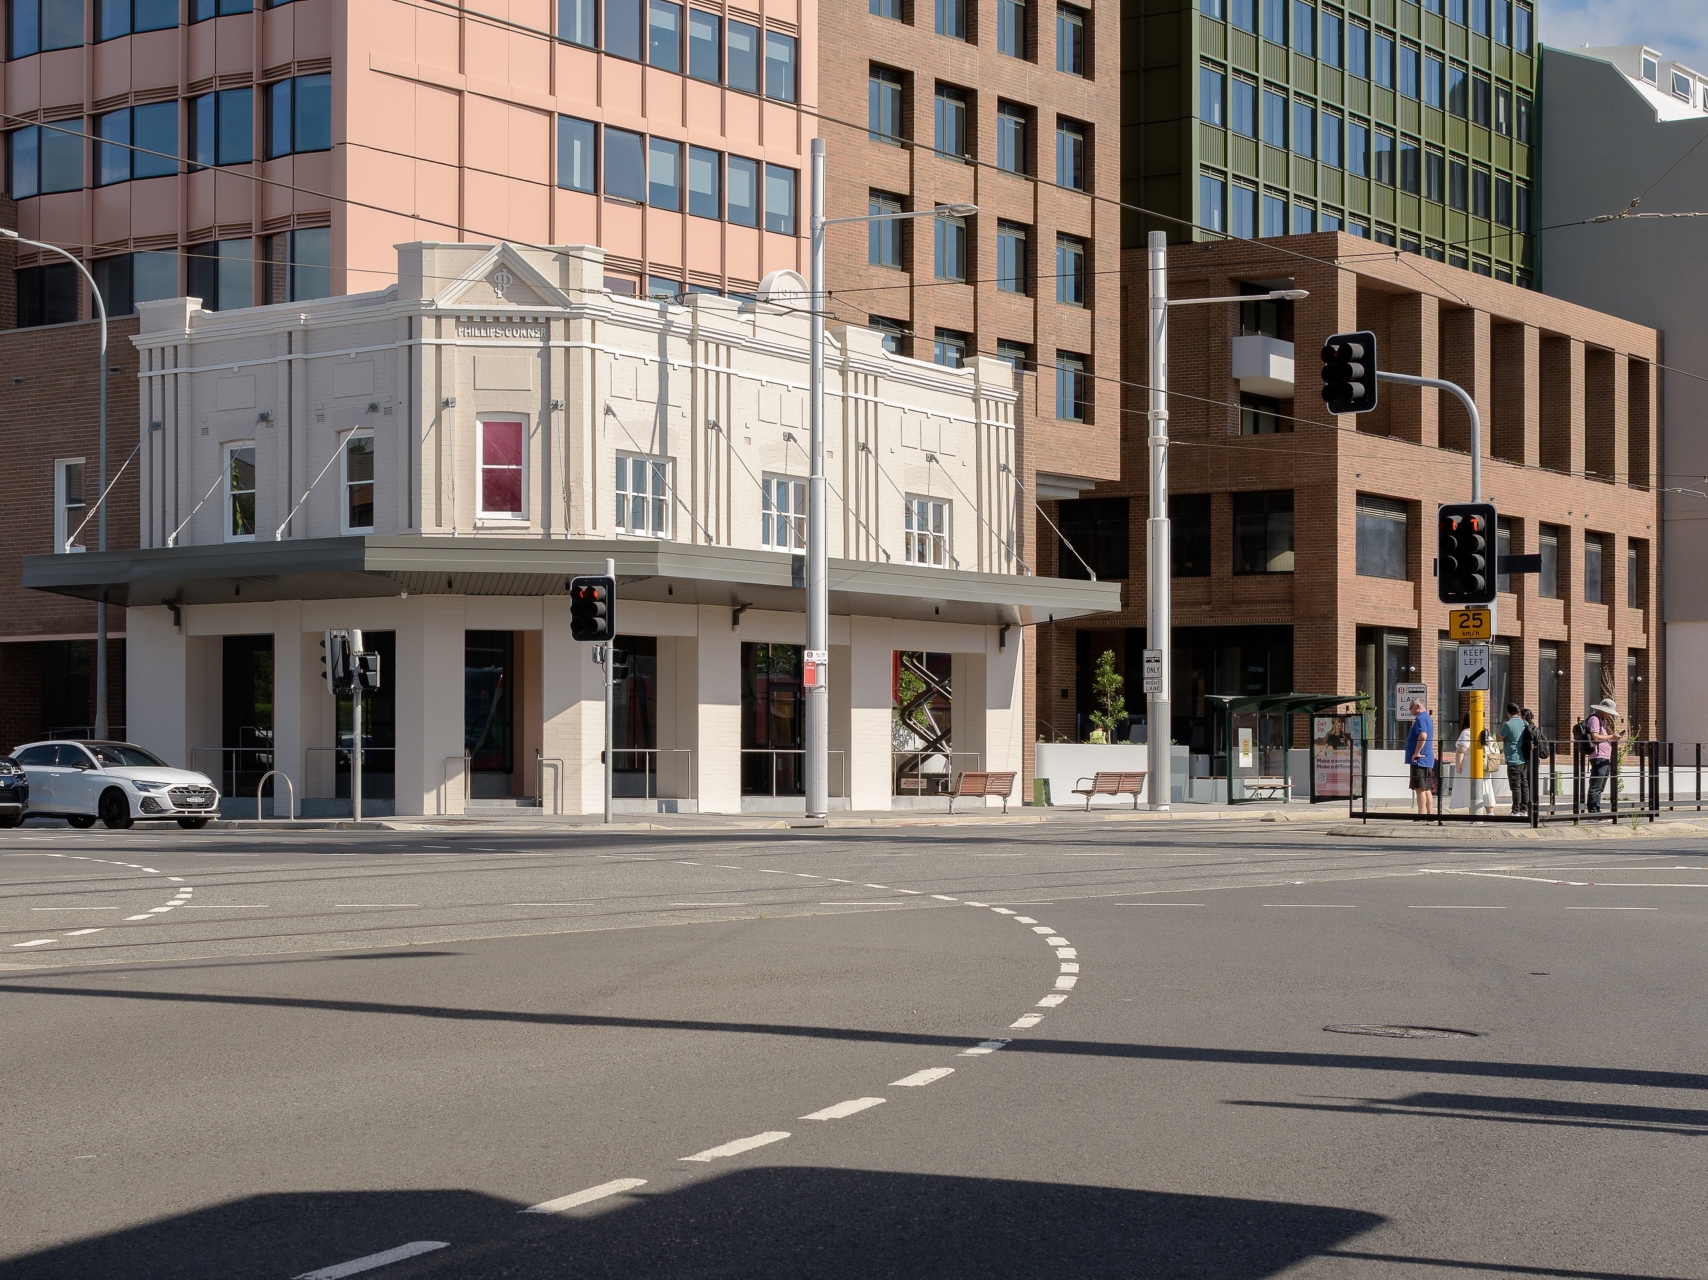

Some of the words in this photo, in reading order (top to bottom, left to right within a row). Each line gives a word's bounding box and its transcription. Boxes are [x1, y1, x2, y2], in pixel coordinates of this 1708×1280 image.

[505, 327, 547, 338] CORNER
[1459, 613, 1483, 628] 25
[1463, 649, 1484, 657] KEEP
[1464, 658, 1483, 666] LEFT
